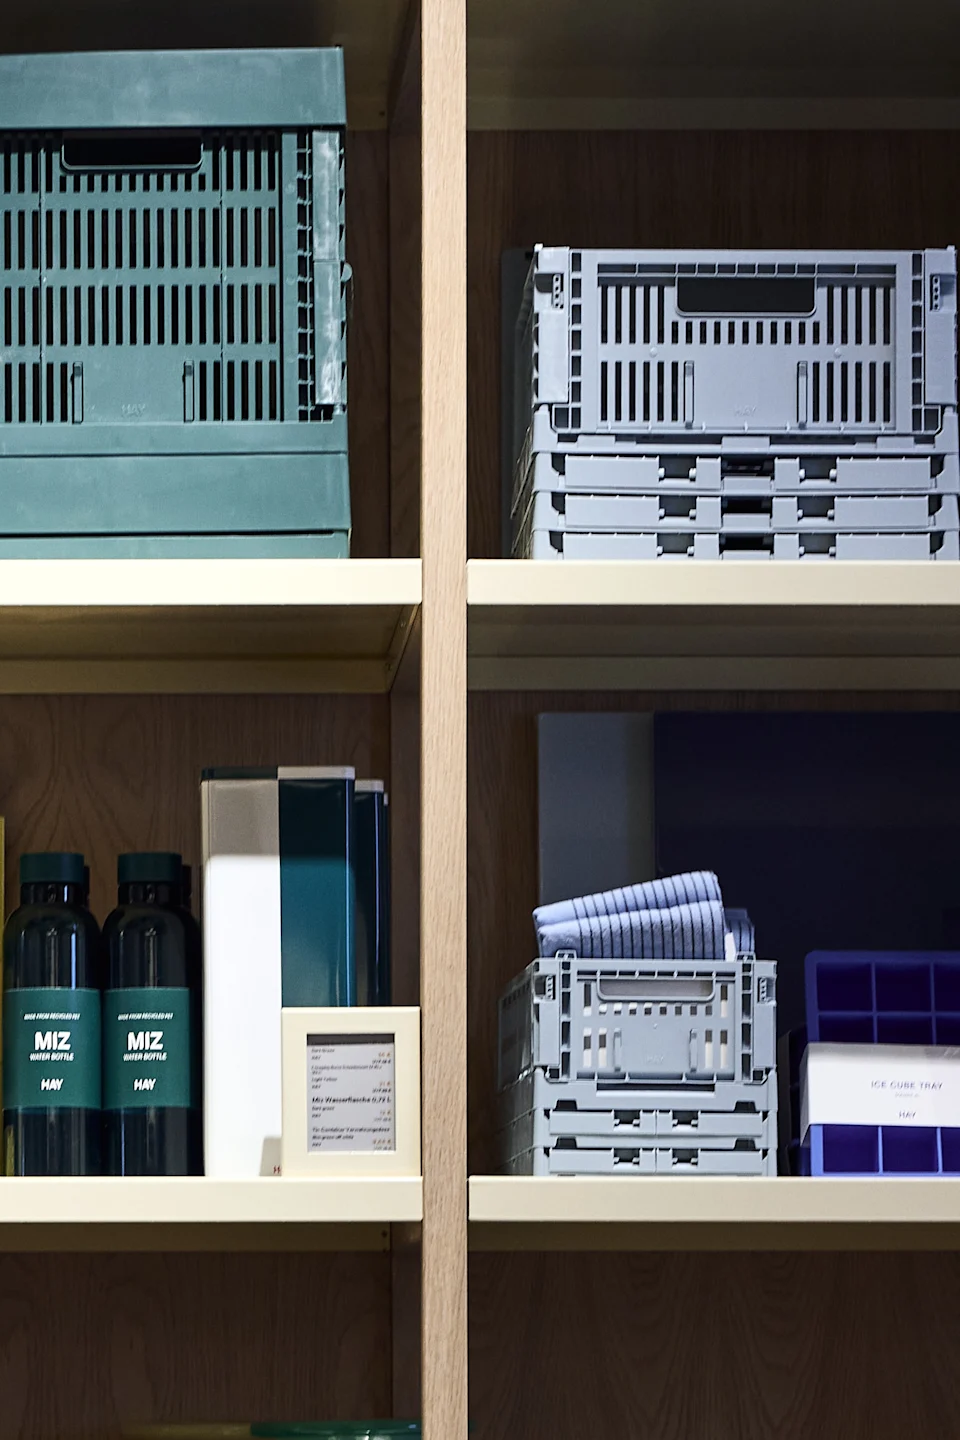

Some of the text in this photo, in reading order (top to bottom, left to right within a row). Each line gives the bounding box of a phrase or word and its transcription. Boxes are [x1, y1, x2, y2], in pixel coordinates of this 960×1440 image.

[34, 1031, 71, 1051] MIZ
[128, 1031, 164, 1051] MIZ
[30, 1052, 74, 1061] WATER BOTTLE
[123, 1052, 167, 1061] WATER BOTTLE
[40, 1078, 64, 1091] HAY
[134, 1078, 156, 1091] HAY
[890, 1081, 915, 1089] CUBE
[920, 1082, 942, 1090] TRAY
[899, 1110, 916, 1119] HAY
